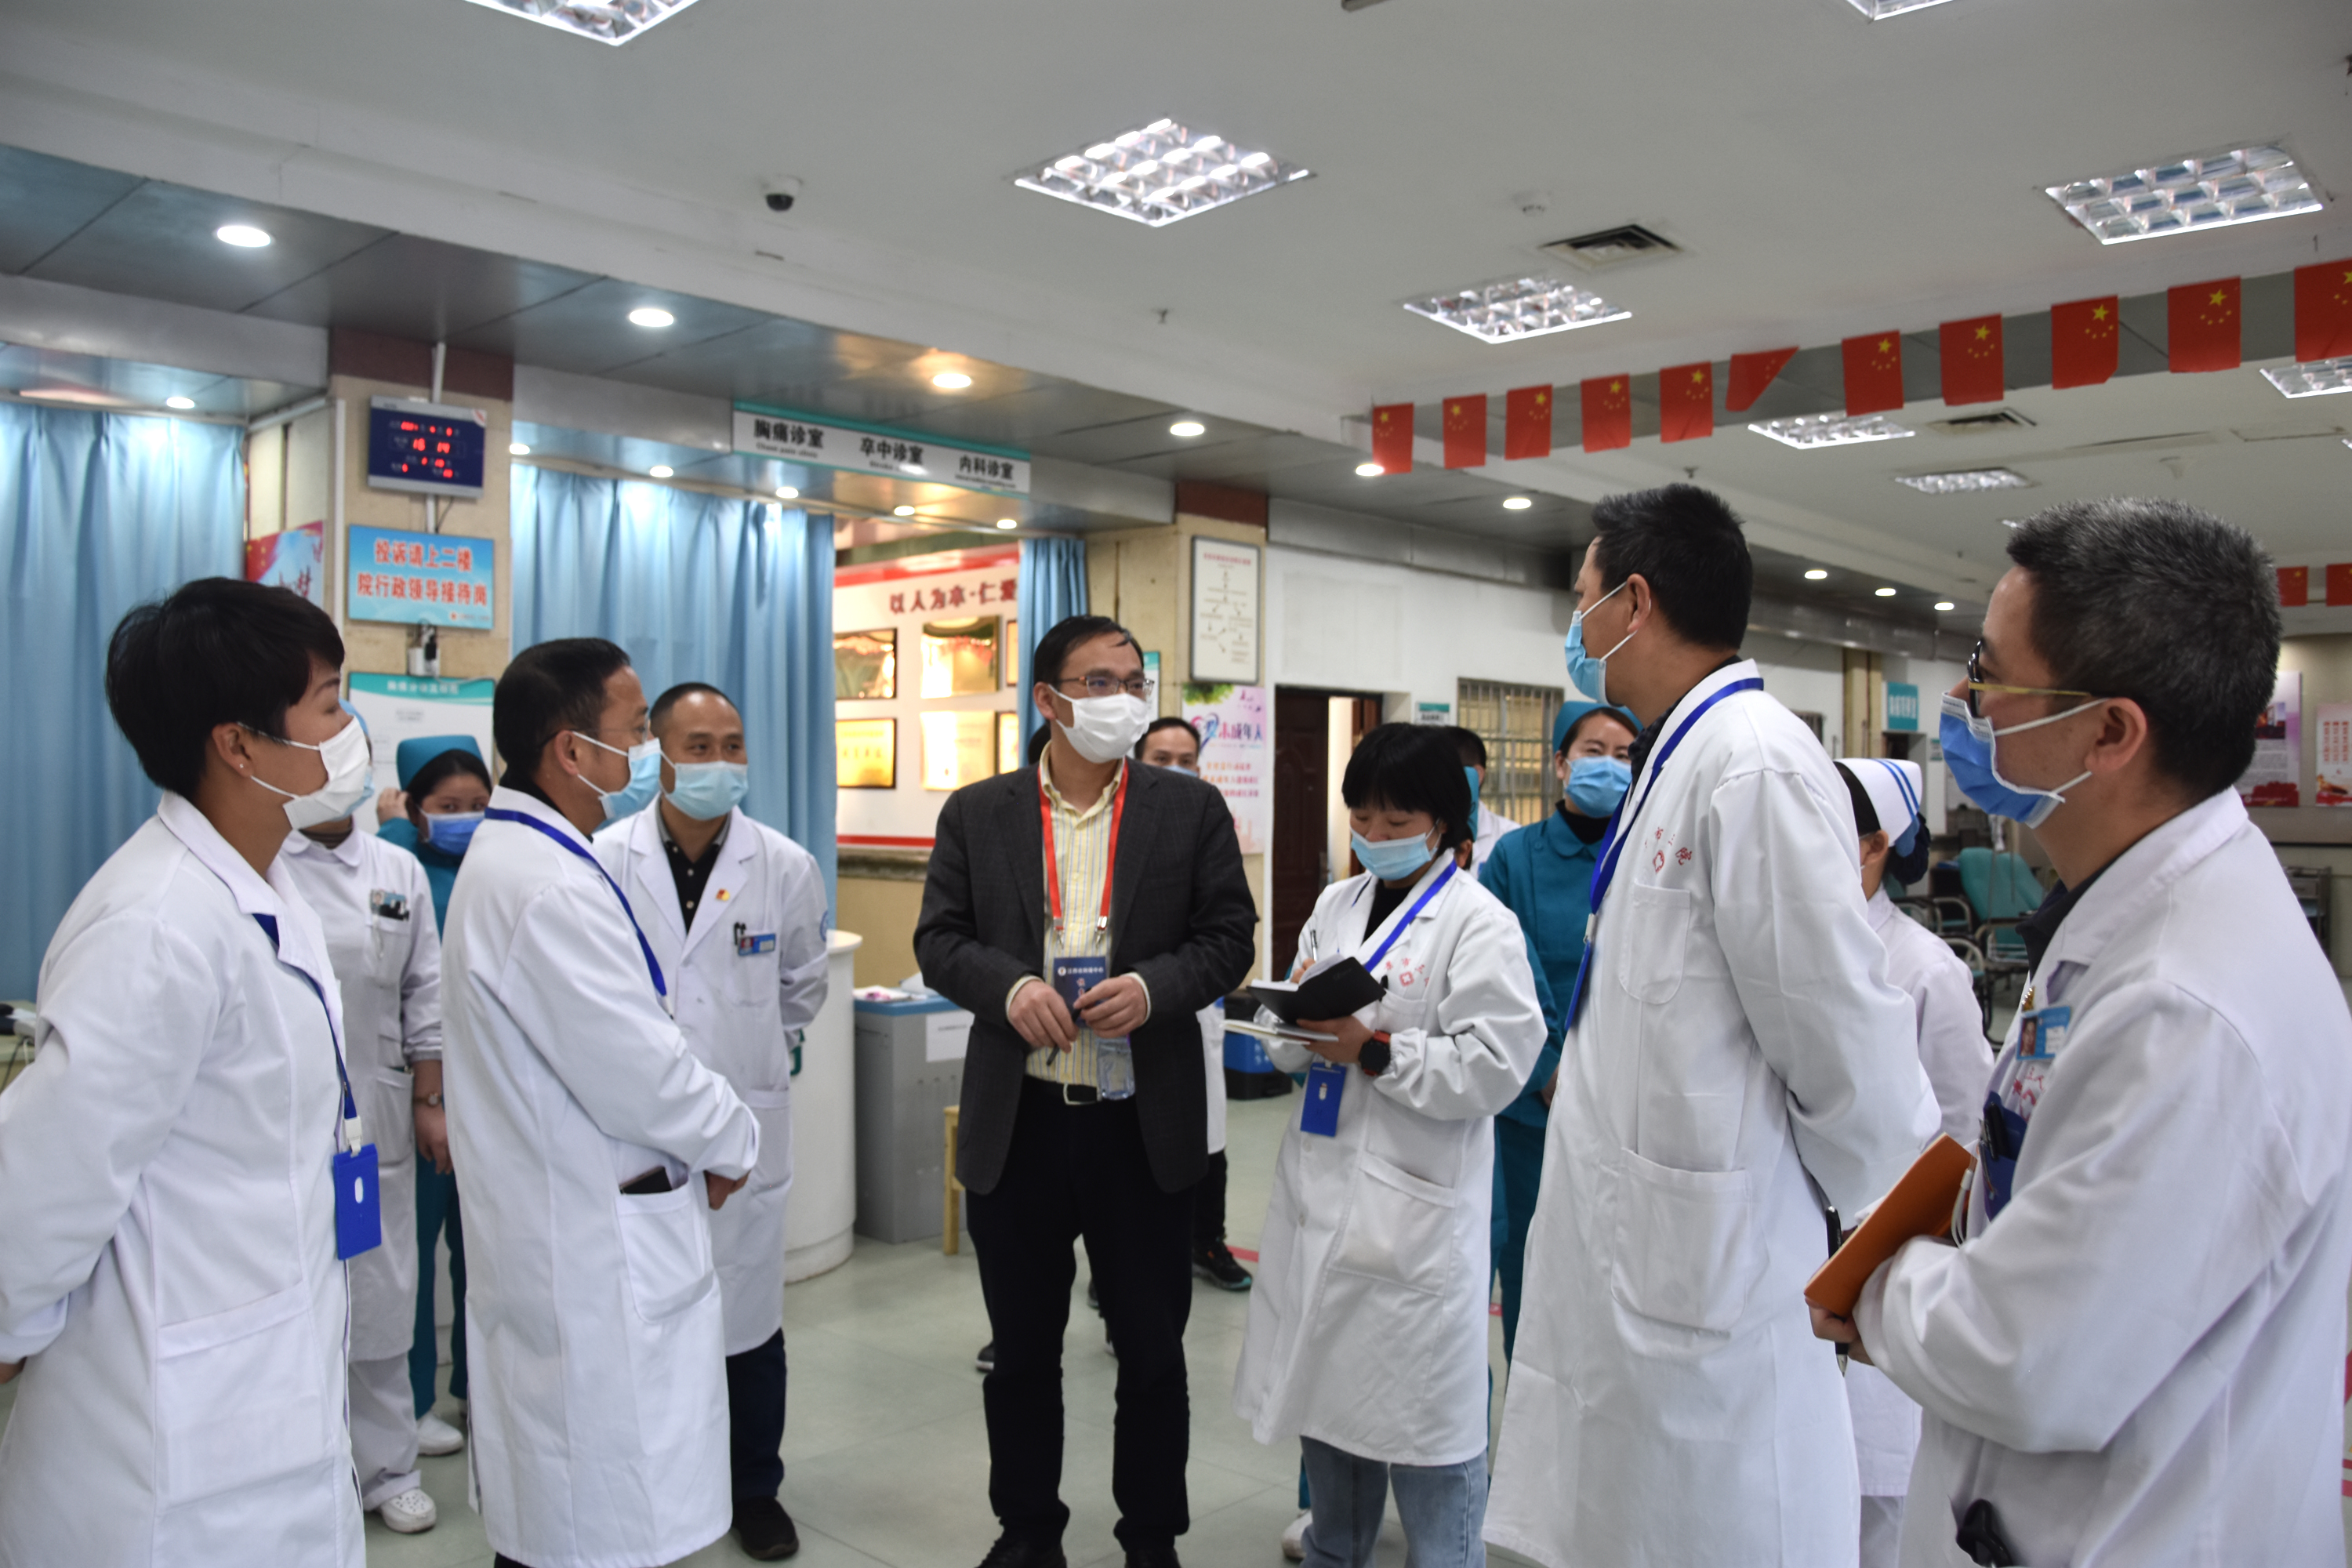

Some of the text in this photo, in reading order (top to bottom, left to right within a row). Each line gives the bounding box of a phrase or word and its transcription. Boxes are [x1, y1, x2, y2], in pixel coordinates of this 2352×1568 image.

[754, 419, 1014, 480] 胸痛诊室 卒中诊室 内科诊室
[374, 538, 473, 572] 投诉请上二楼
[357, 572, 488, 606] 院行政领导接待岗
